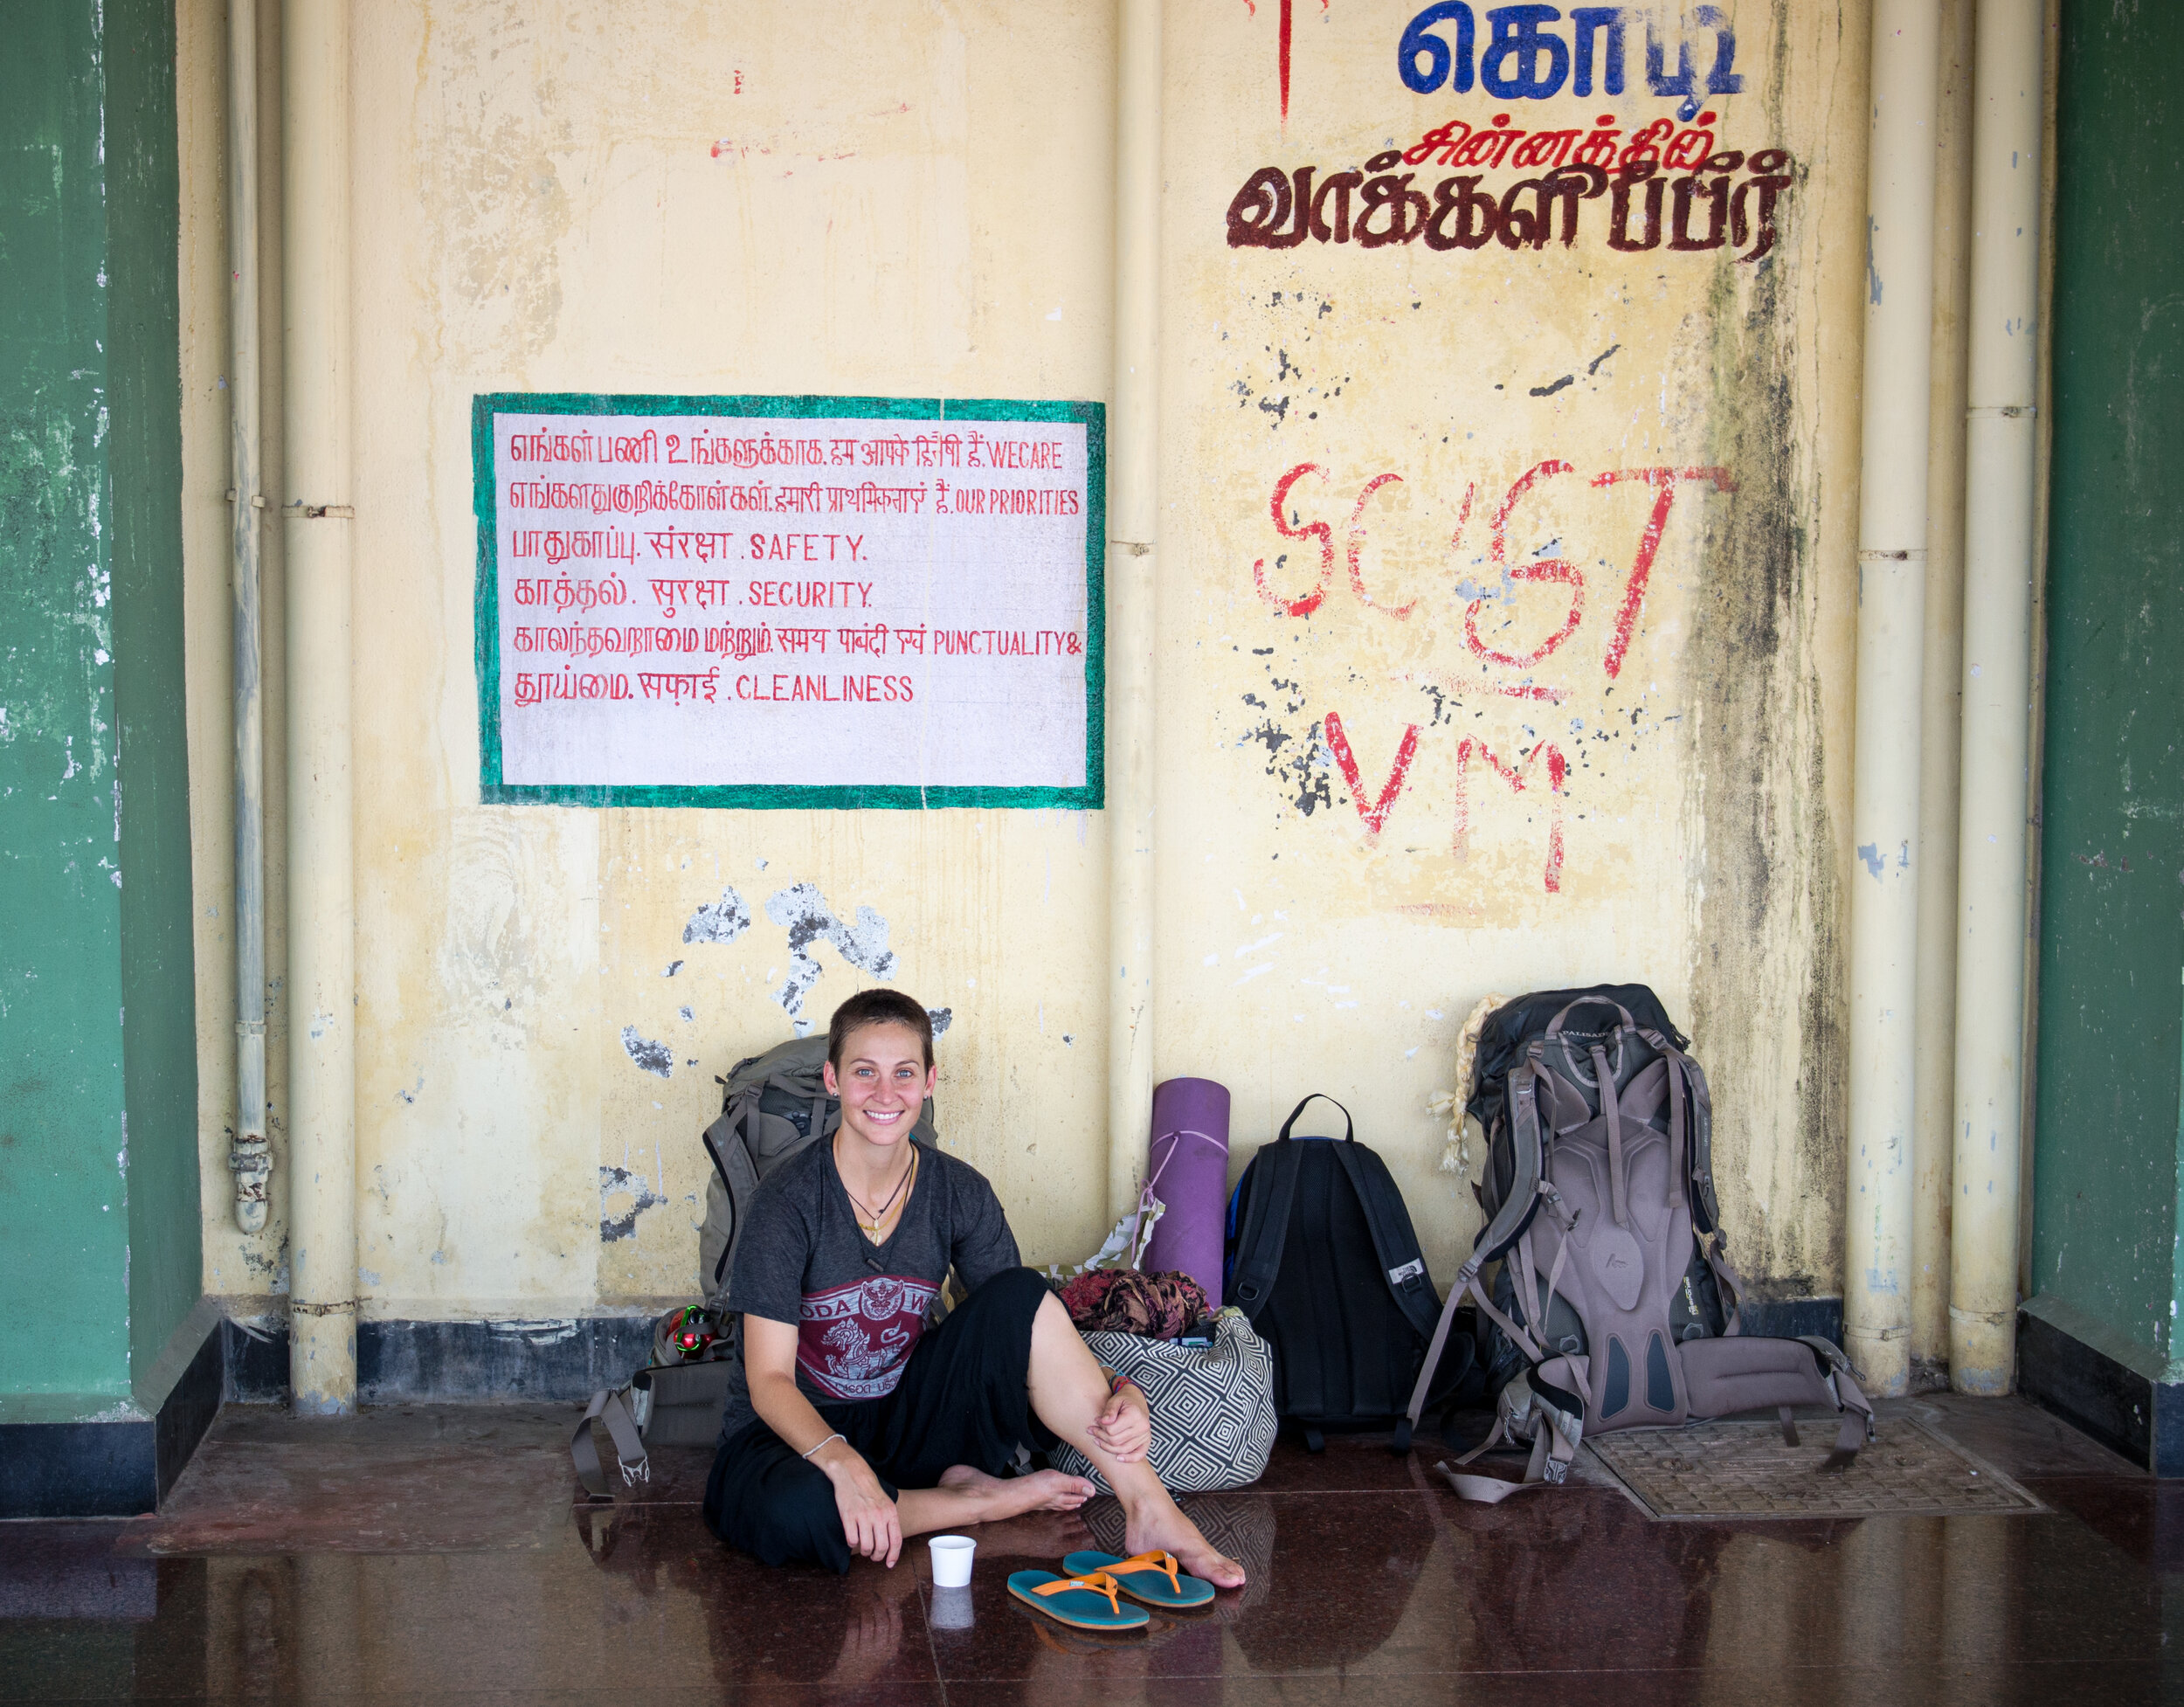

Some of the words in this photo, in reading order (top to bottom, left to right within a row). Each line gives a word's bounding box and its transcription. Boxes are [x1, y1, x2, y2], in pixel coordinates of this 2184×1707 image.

[1397, 0, 1746, 121] கொடி
[510, 425, 595, 463] எங்கள்
[598, 428, 658, 464] பணி
[828, 439, 860, 466] हम
[860, 432, 910, 467] आपके
[956, 488, 986, 515] OUR
[989, 488, 1080, 516] PRIORITIES
[837, 622, 890, 658] पाबंदी
[798, 1299, 851, 1319] ODA
[910, 1292, 930, 1313] W
